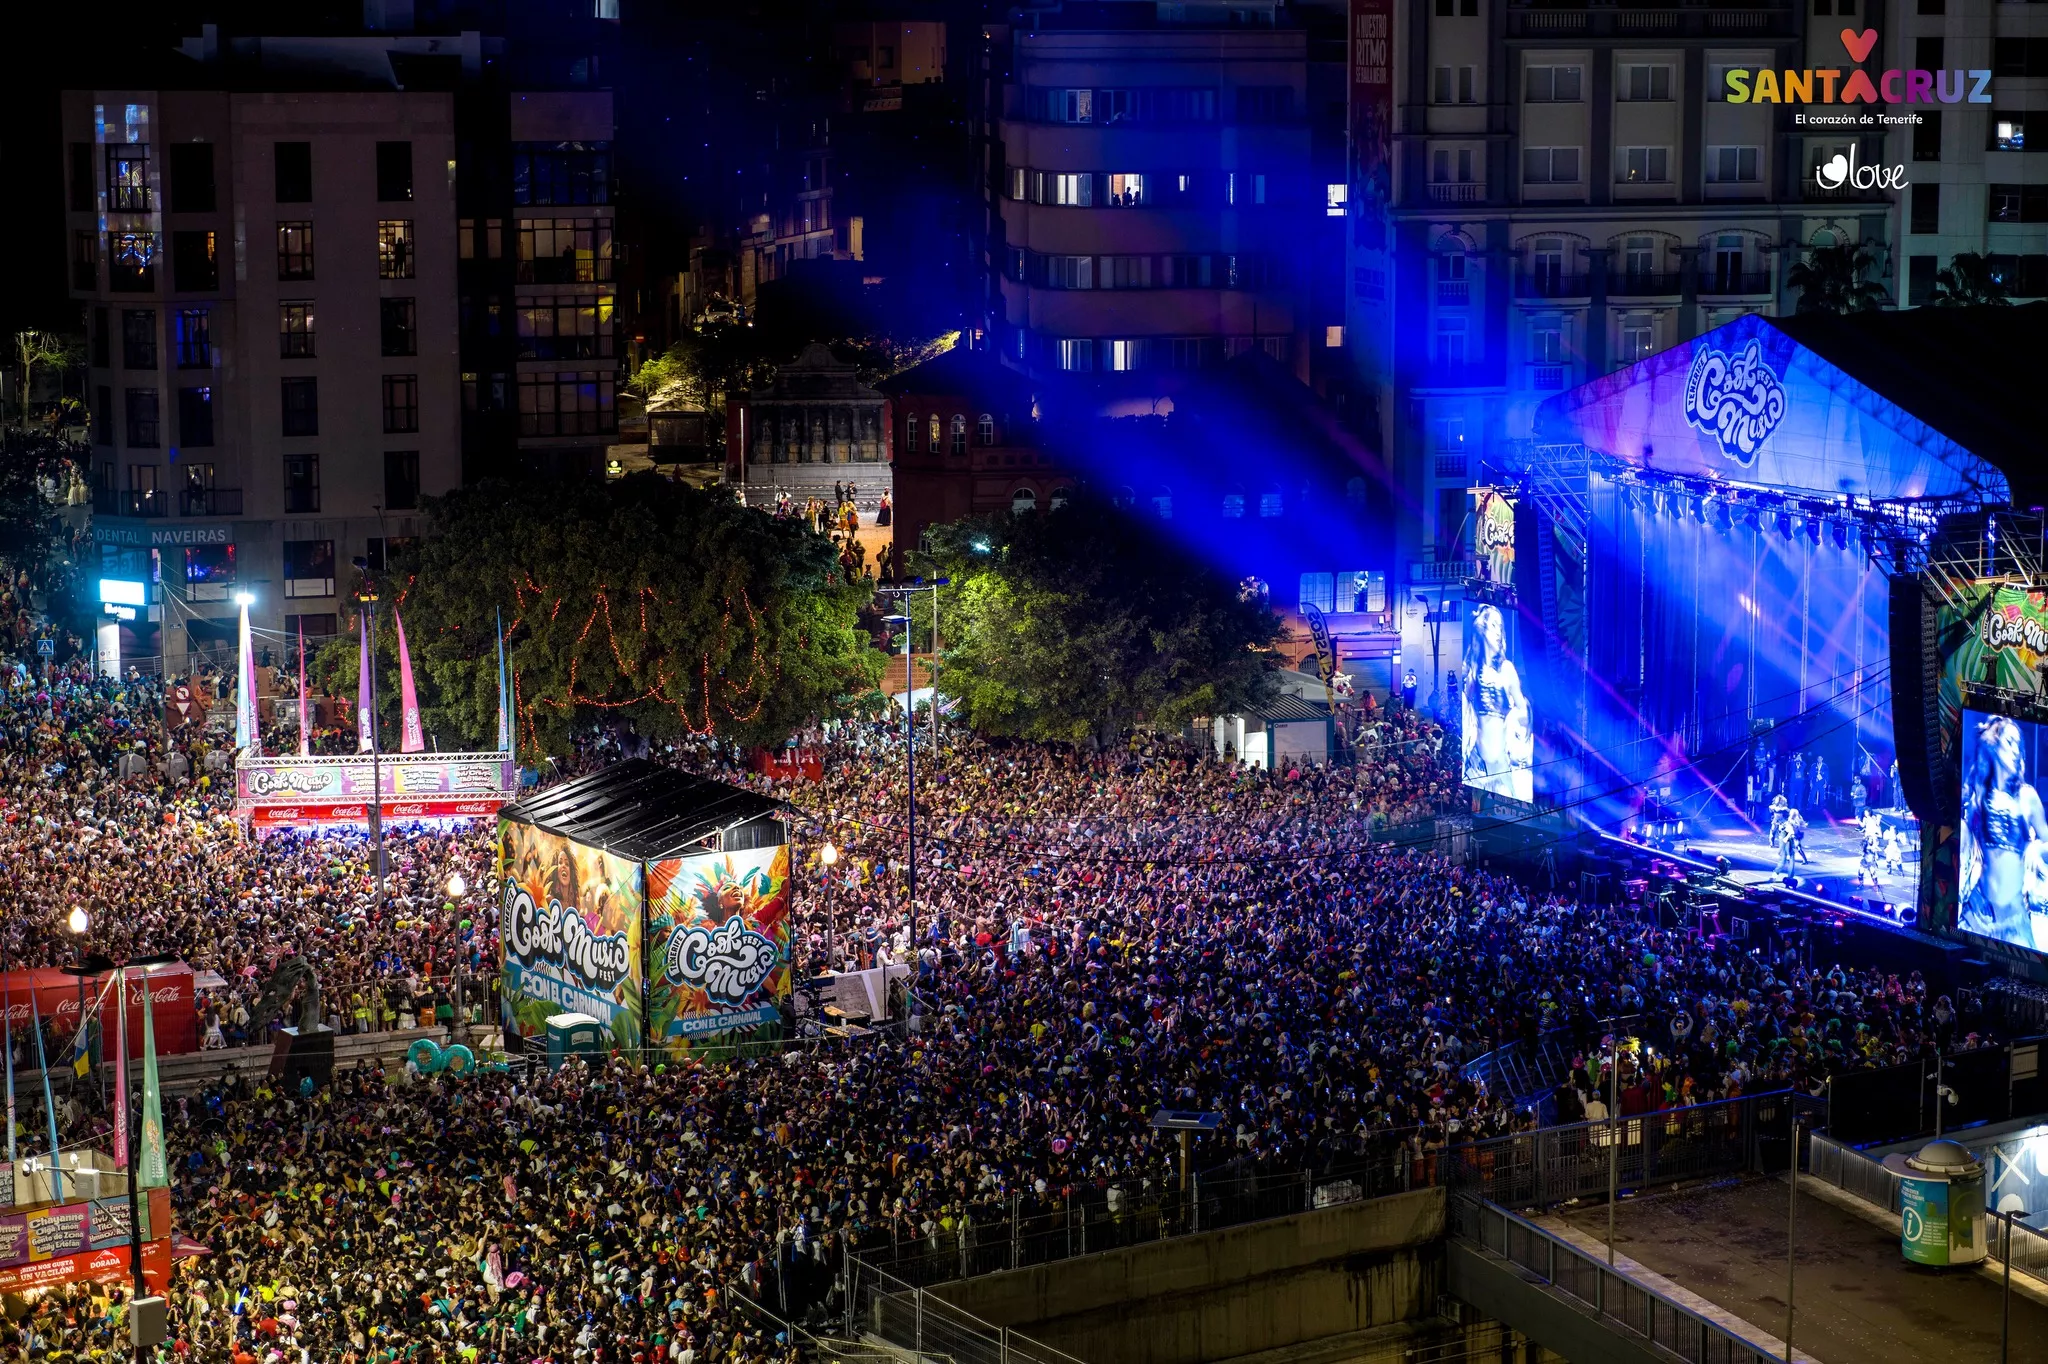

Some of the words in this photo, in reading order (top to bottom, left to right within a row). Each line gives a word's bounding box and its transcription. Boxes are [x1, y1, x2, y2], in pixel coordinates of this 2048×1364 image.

[1361, 14, 1387, 38] NUESTRO
[1356, 39, 1386, 66] RITMO
[1688, 358, 1704, 406] TENERIFE
[1757, 370, 1774, 389] FEST
[1717, 389, 1784, 453] Music
[97, 529, 140, 544] DENTAL
[152, 529, 226, 544] NAVEIRAS
[1485, 519, 1509, 546] Cook
[1990, 614, 2024, 646] Cook
[505, 889, 515, 935] TENERIFE
[511, 892, 562, 956] Cook
[563, 913, 630, 979] Music
[742, 935, 763, 947] FEST
[669, 935, 684, 975] TENERIFE
[599, 970, 615, 982] FEST
[705, 945, 774, 997] Music
[520, 971, 551, 998] CON
[550, 982, 561, 1005] EL
[562, 987, 613, 1026] CARNAVAL
[682, 1020, 708, 1032] CON
[708, 1019, 717, 1029] EL
[718, 1011, 762, 1028] CARNAVAL
[28, 1214, 84, 1229] Chayanne
[36, 1226, 56, 1236] Olga
[97, 1222, 113, 1232] Tito
[64, 1231, 83, 1240] Zona
[37, 1242, 56, 1252] Emily
[38, 1263, 51, 1271] NOS
[52, 1259, 74, 1269] GUSTA
[90, 1257, 121, 1269] DORADA
[20, 1272, 33, 1282] UN
